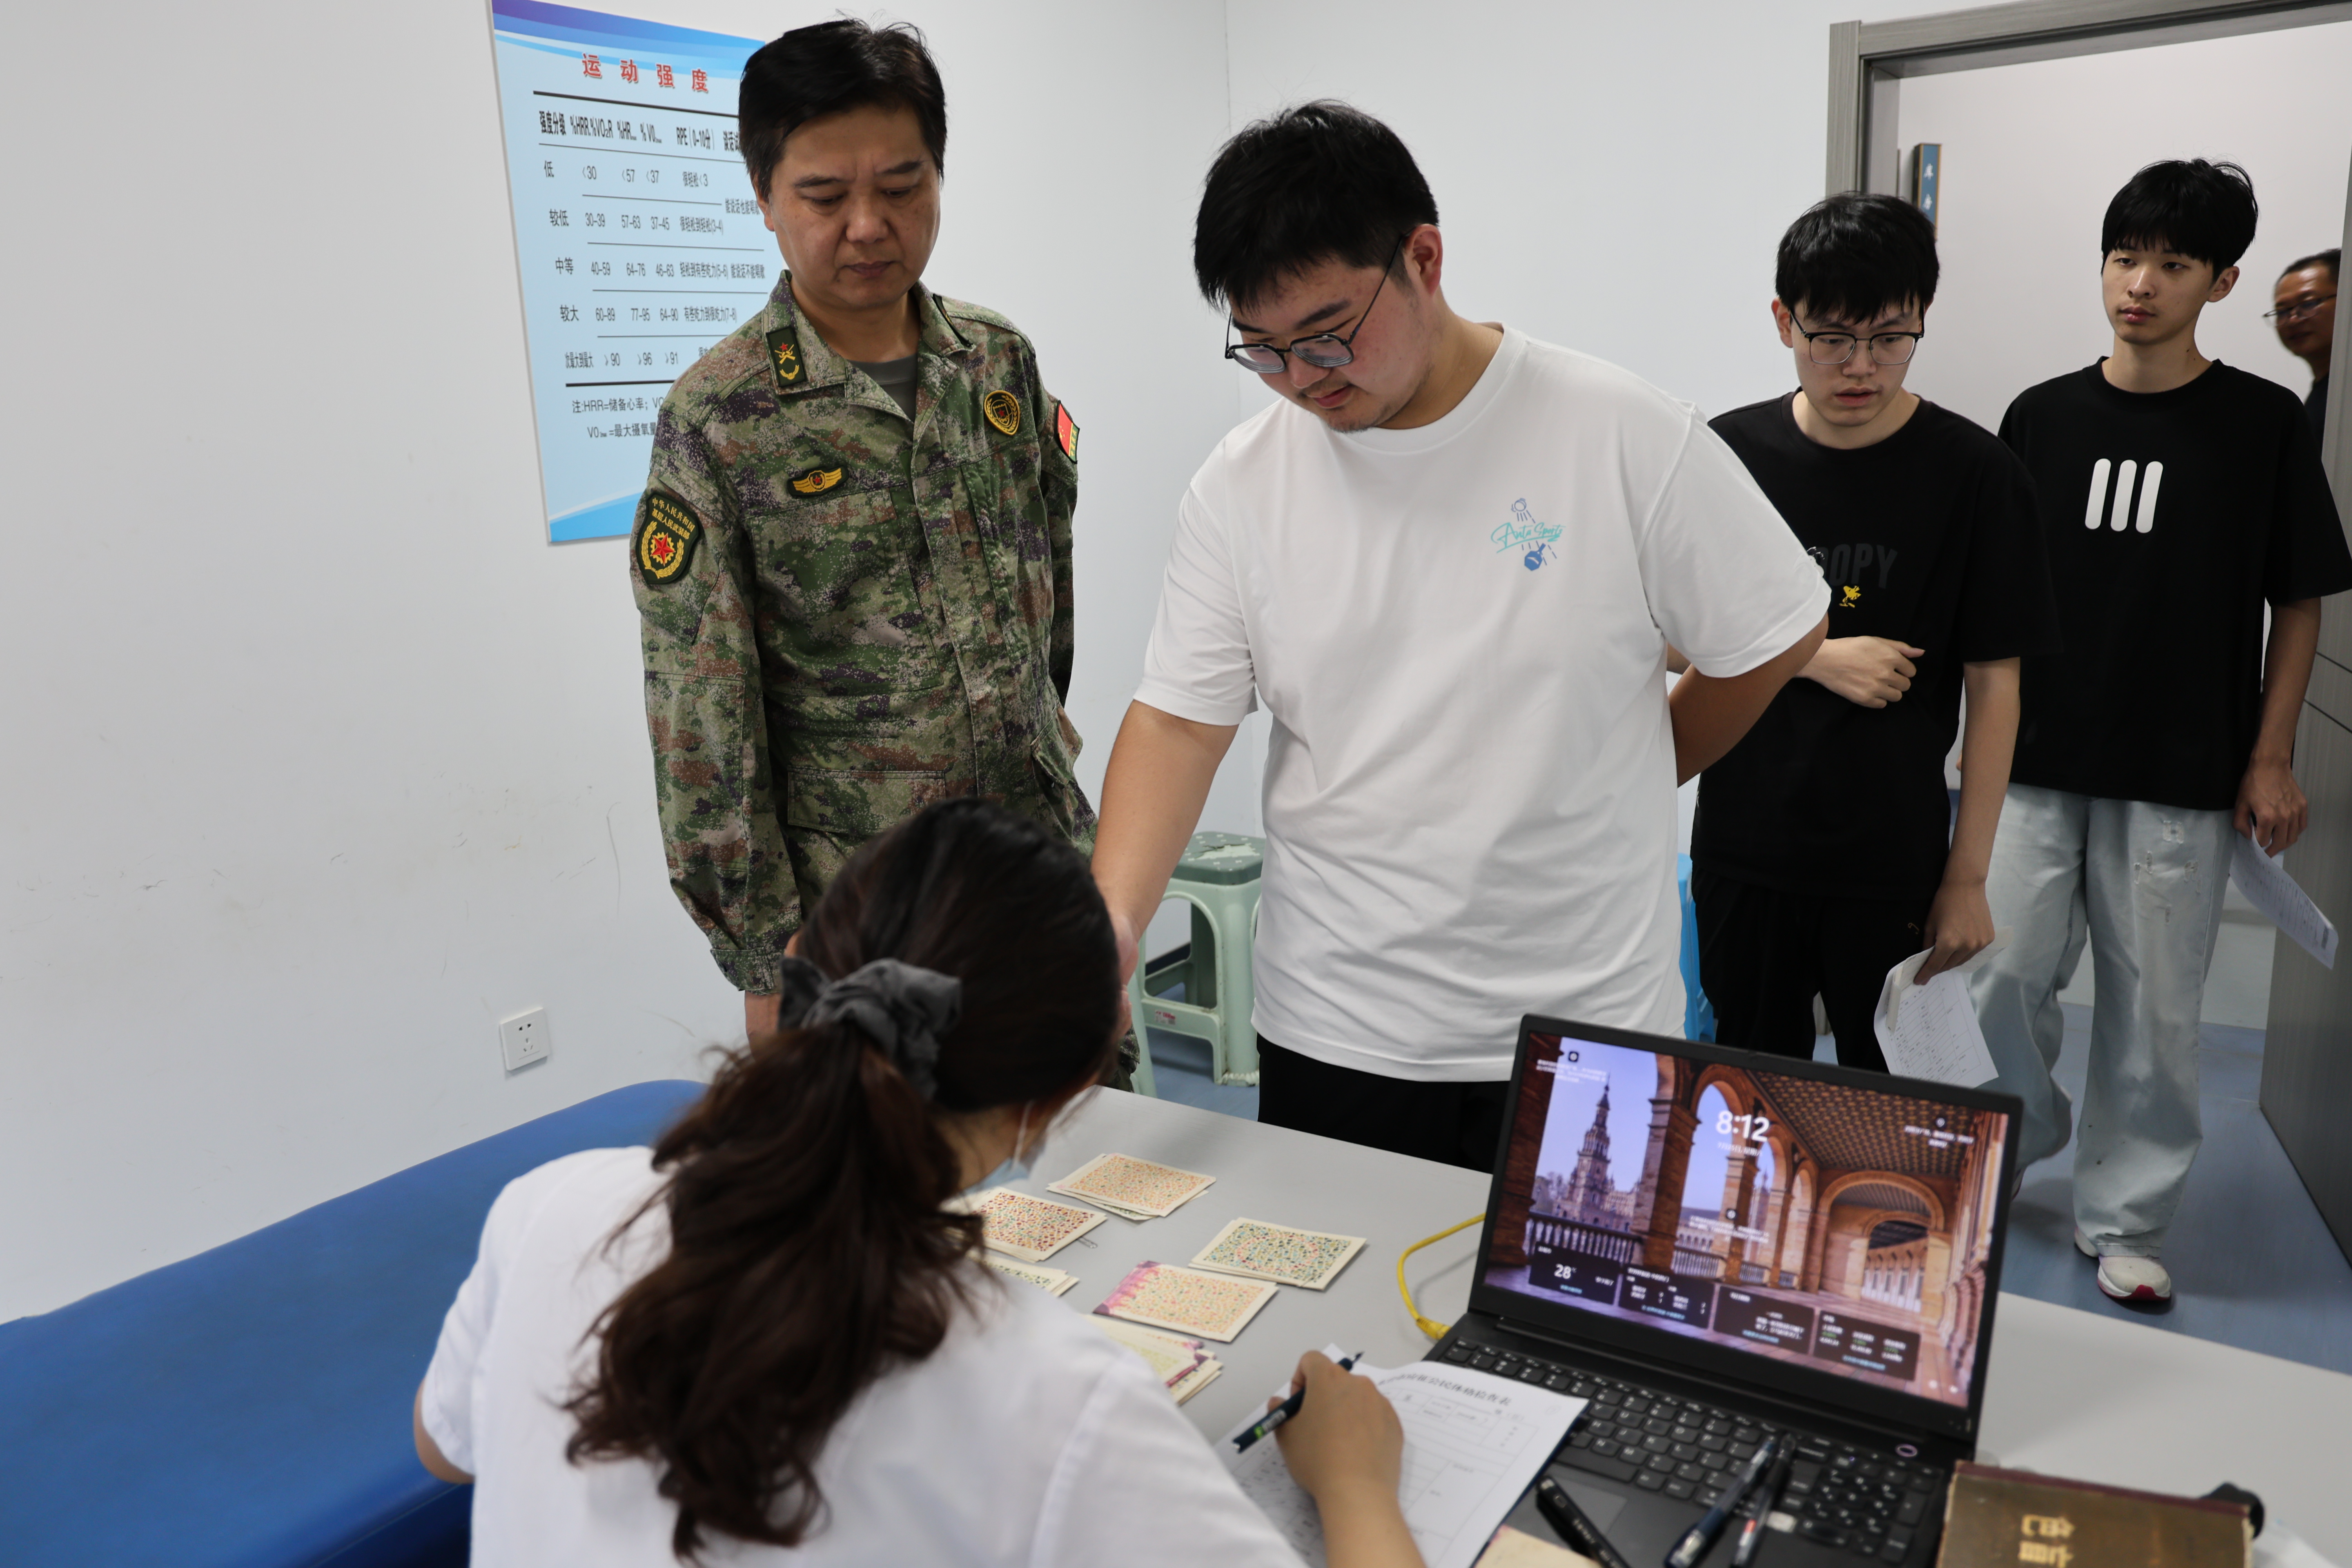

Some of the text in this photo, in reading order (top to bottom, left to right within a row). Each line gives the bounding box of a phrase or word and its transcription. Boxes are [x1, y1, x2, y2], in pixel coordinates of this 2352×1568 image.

[582, 53, 708, 92] 运动强度
[539, 111, 566, 135] 强度分级
[544, 160, 554, 177] 低
[550, 209, 569, 226] 较低
[585, 213, 605, 227] 30-39
[621, 215, 641, 229] 57-63
[651, 216, 670, 230] 37-45
[555, 257, 573, 274] 中等
[591, 262, 610, 275] 40-59
[626, 263, 646, 276] 64-76
[655, 263, 674, 277] 46-63
[560, 305, 579, 321] 较大
[595, 308, 615, 321] 60-89
[631, 308, 650, 321] 77-95
[660, 308, 678, 321] 64-90
[652, 497, 695, 532] 中华人民共和国
[652, 508, 690, 540] 基层人民武装部
[1716, 1110, 1770, 1142] 8:12
